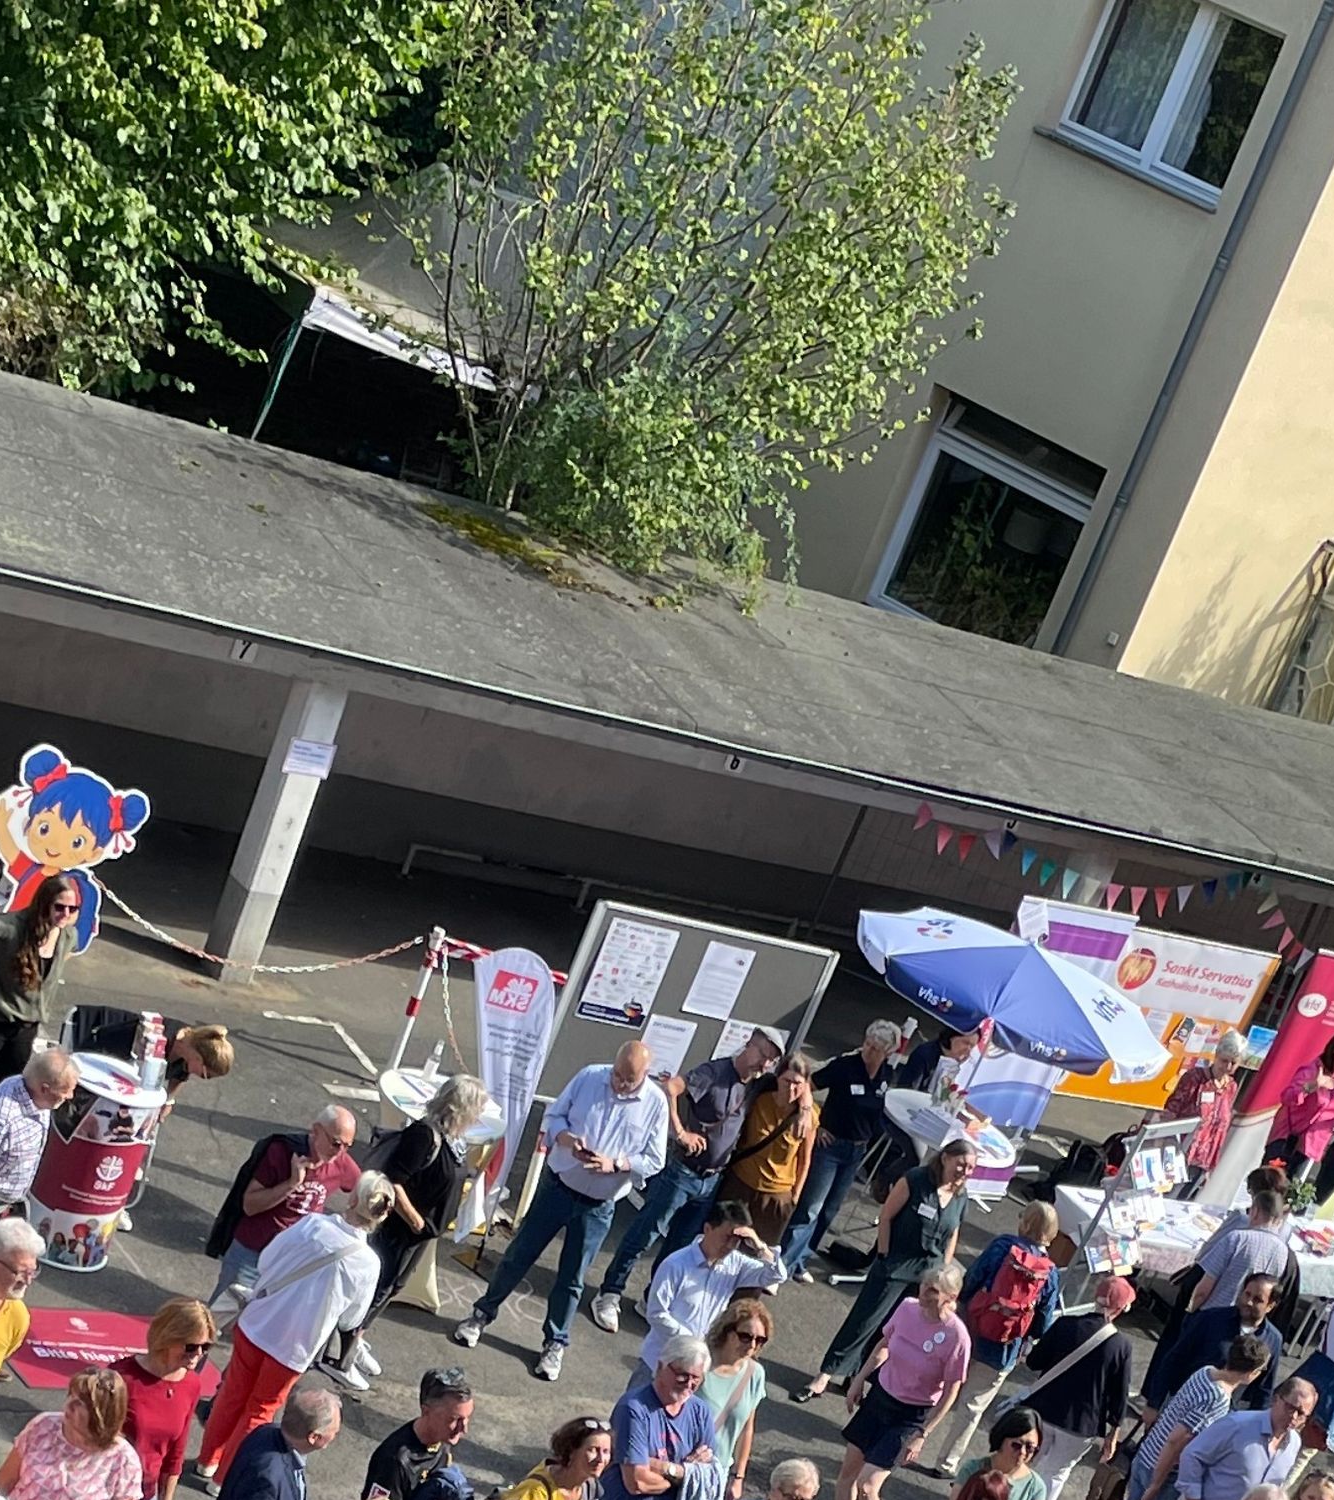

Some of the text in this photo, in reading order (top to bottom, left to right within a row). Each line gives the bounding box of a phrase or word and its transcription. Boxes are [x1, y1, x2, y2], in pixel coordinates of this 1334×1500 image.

[730, 754, 741, 770] 6
[1162, 960, 1255, 989] Sankt Servatius
[918, 985, 938, 1006] vhs
[1155, 977, 1247, 1004] Katholisch in Siegburg
[1030, 1041, 1053, 1057] vhs
[93, 1179, 116, 1192] SkF
[33, 1346, 79, 1361] Bitte
[82, 1349, 118, 1363] hier
